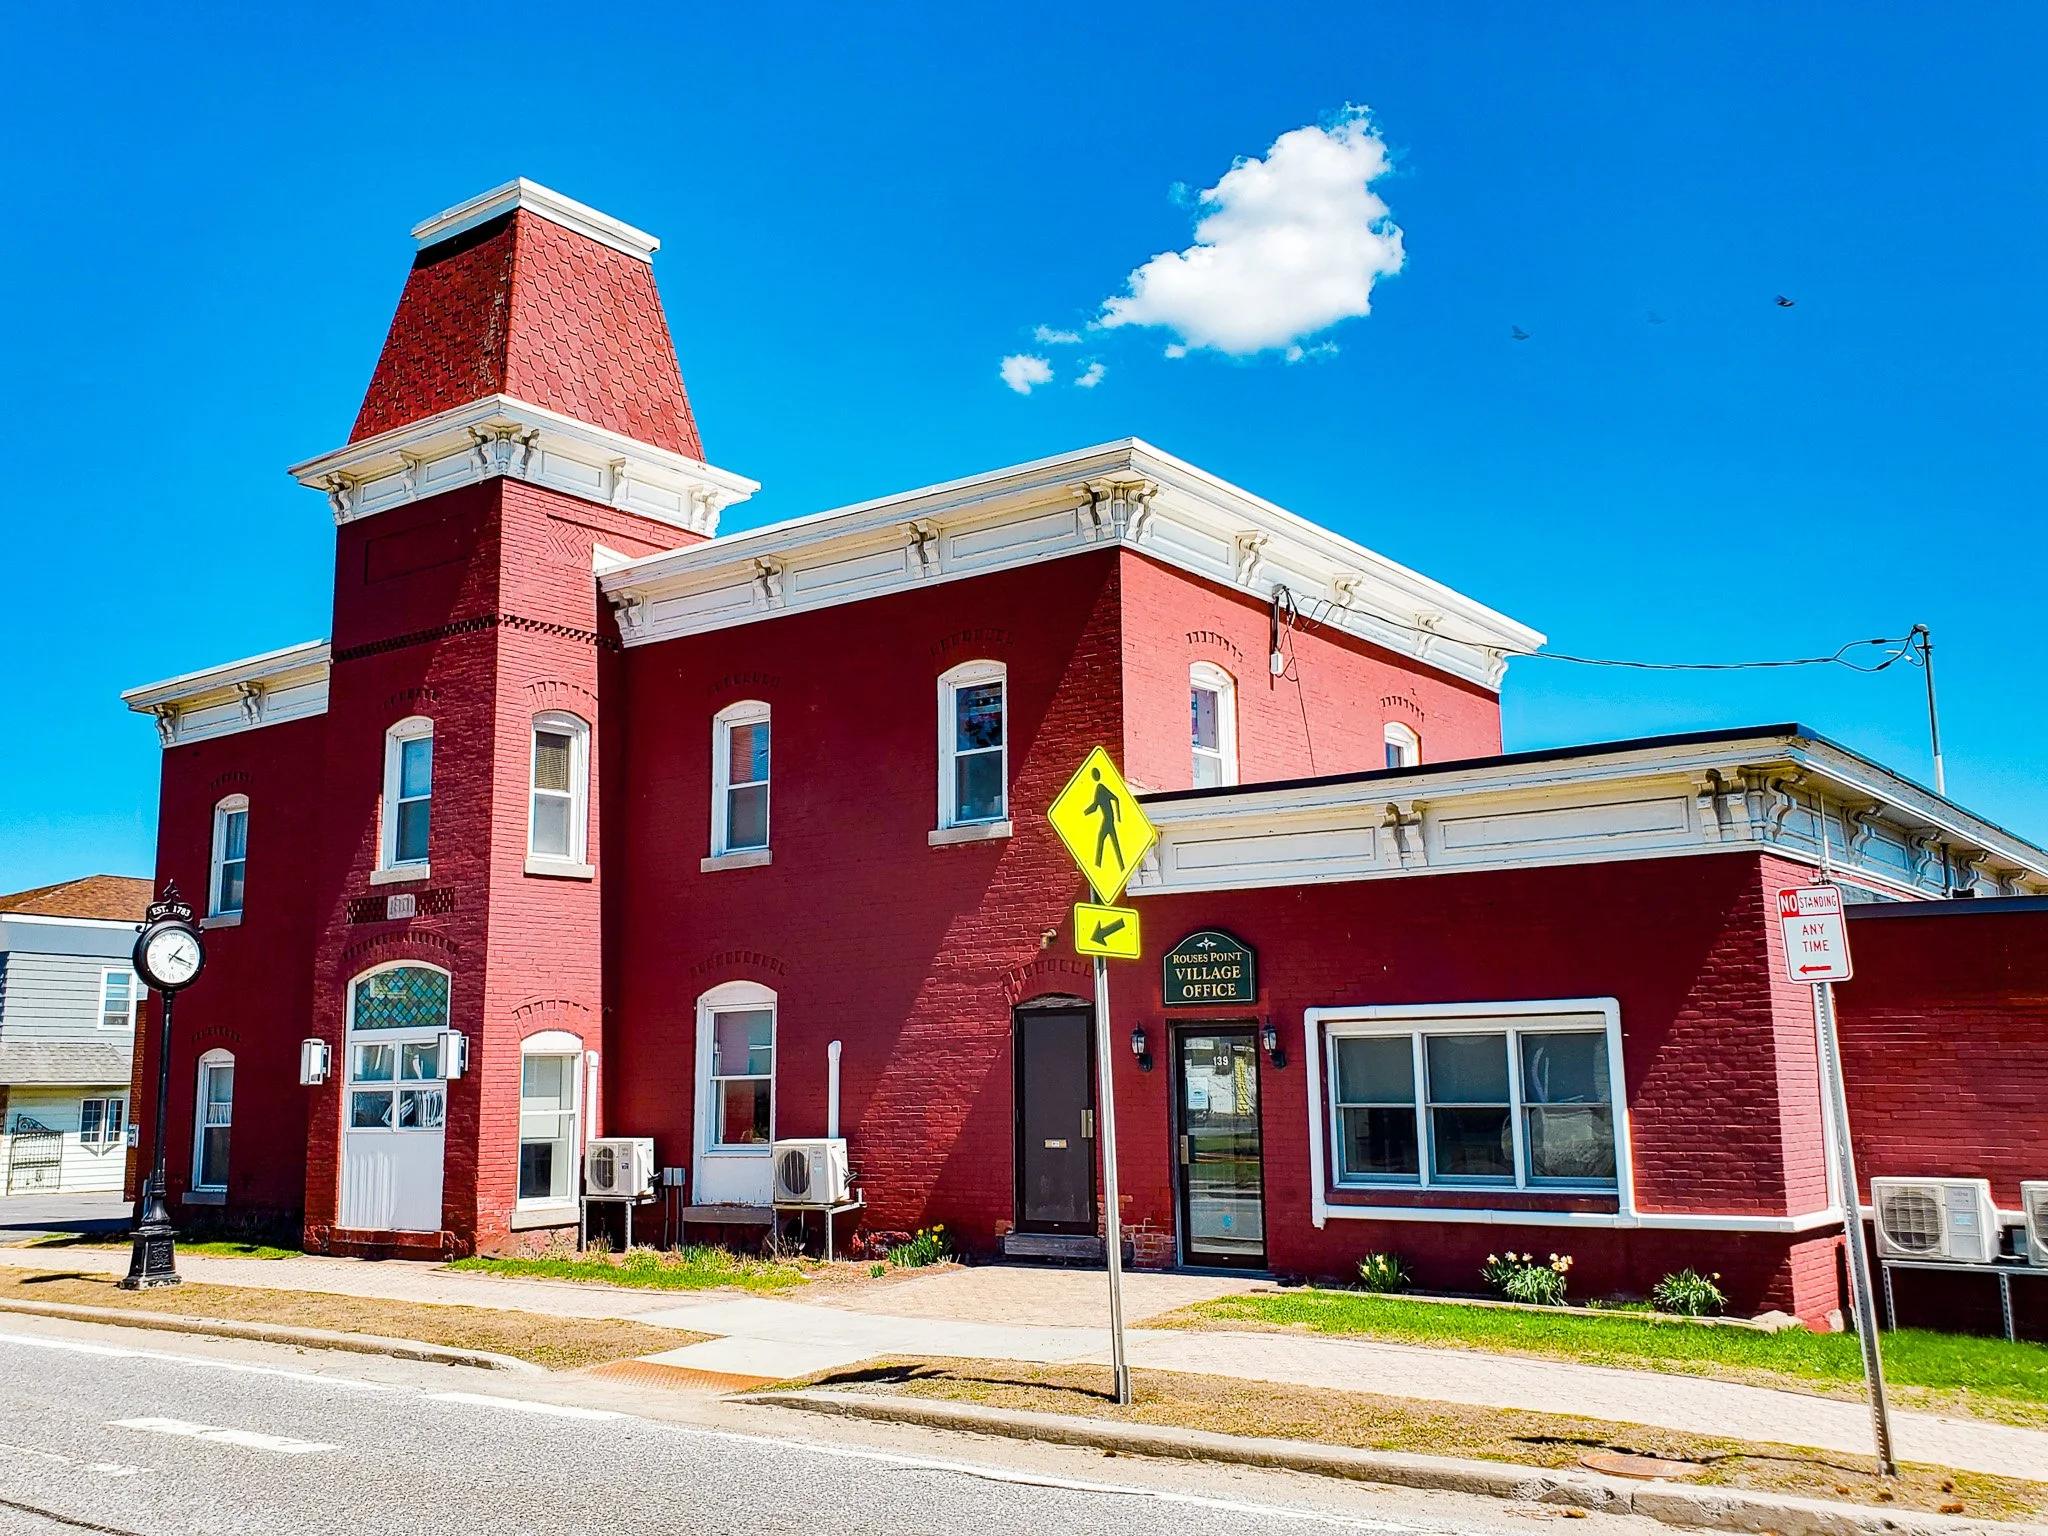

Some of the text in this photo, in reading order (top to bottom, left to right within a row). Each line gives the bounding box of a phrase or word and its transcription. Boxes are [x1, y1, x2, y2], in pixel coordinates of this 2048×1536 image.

[1780, 895, 1837, 913] NO STANDING
[151, 905, 191, 917] EST. 1783
[1802, 923, 1825, 936] ANY
[1802, 940, 1830, 953] TIME
[1172, 952, 1243, 964] ROUSES POINT
[1174, 965, 1242, 981] VILLAGE
[1182, 983, 1237, 998] OFFICE
[1213, 1055, 1229, 1066] 139
